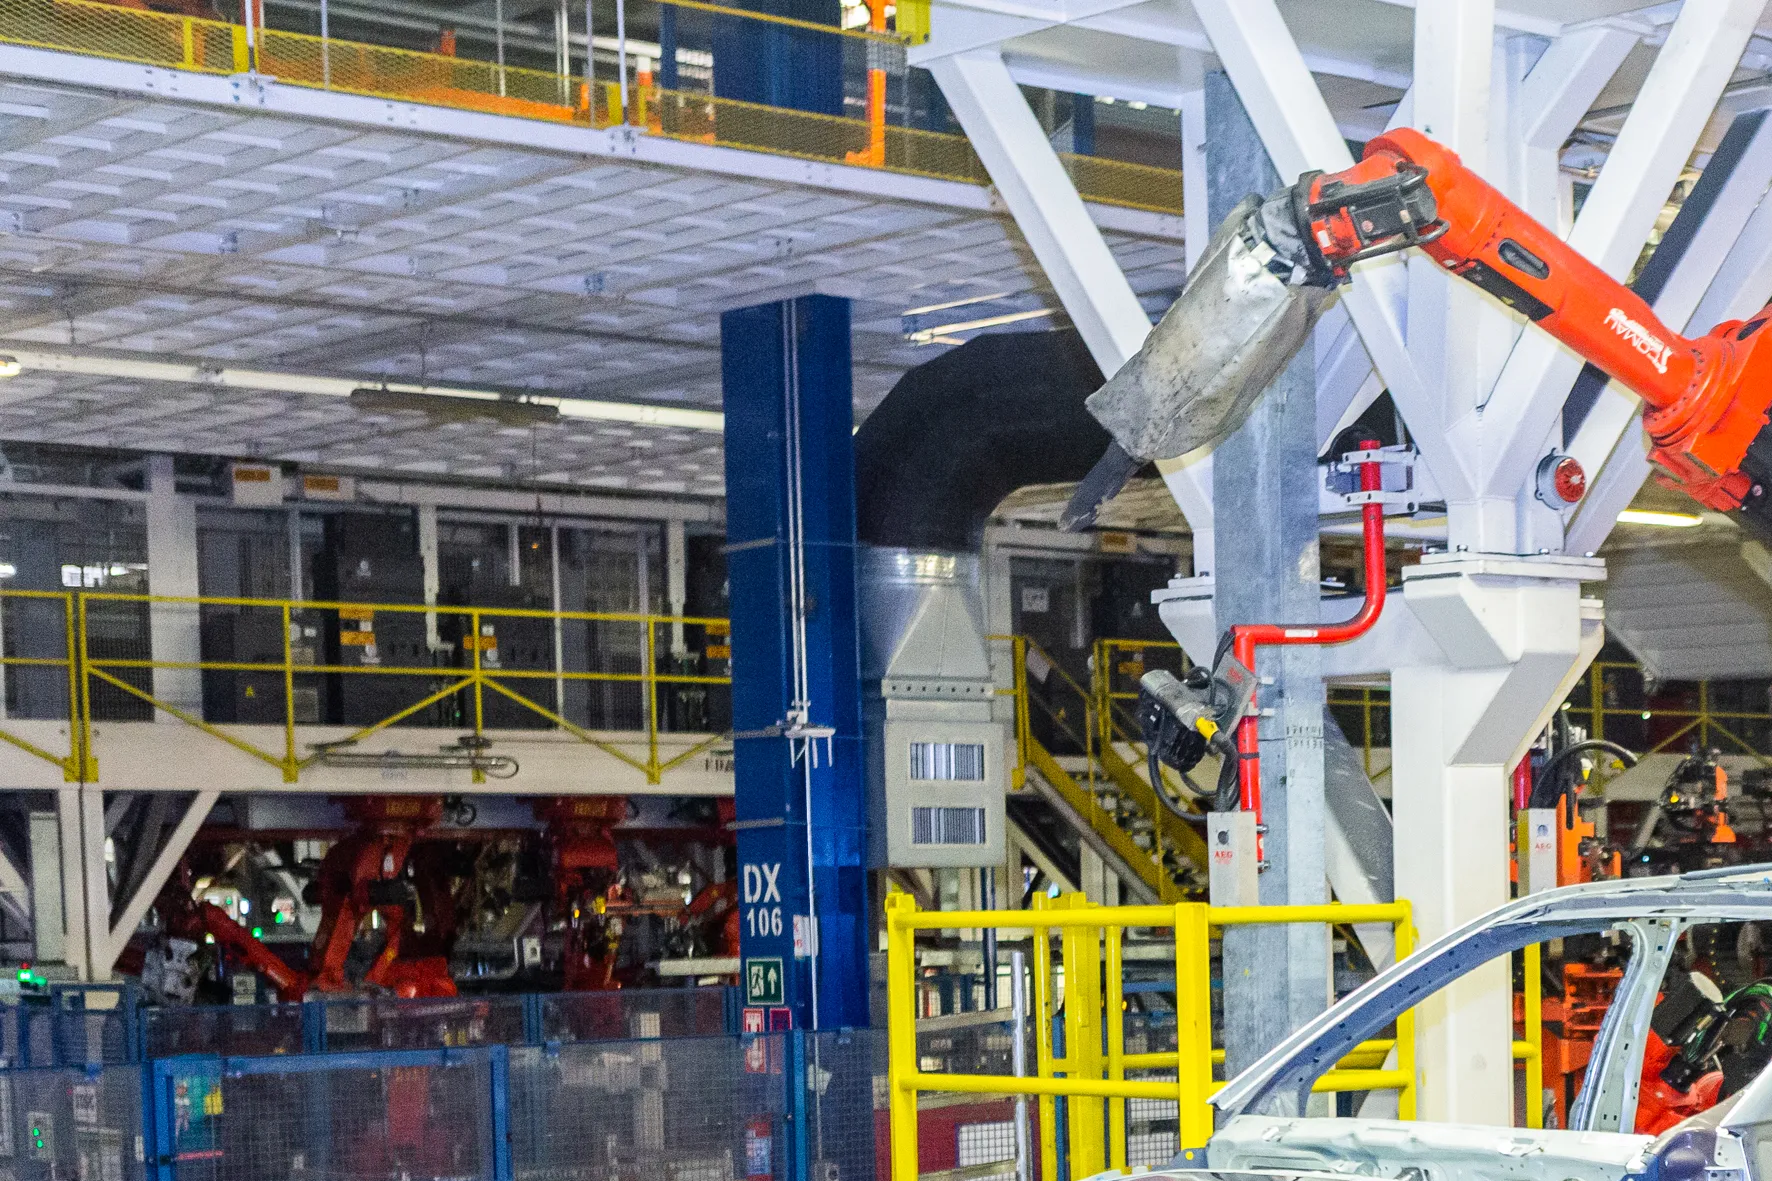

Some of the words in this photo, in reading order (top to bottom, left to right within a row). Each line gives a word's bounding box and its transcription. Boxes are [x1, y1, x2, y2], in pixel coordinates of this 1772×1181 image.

[1214, 850, 1233, 859] AEG
[743, 863, 781, 904] DX
[746, 907, 783, 937] 106
